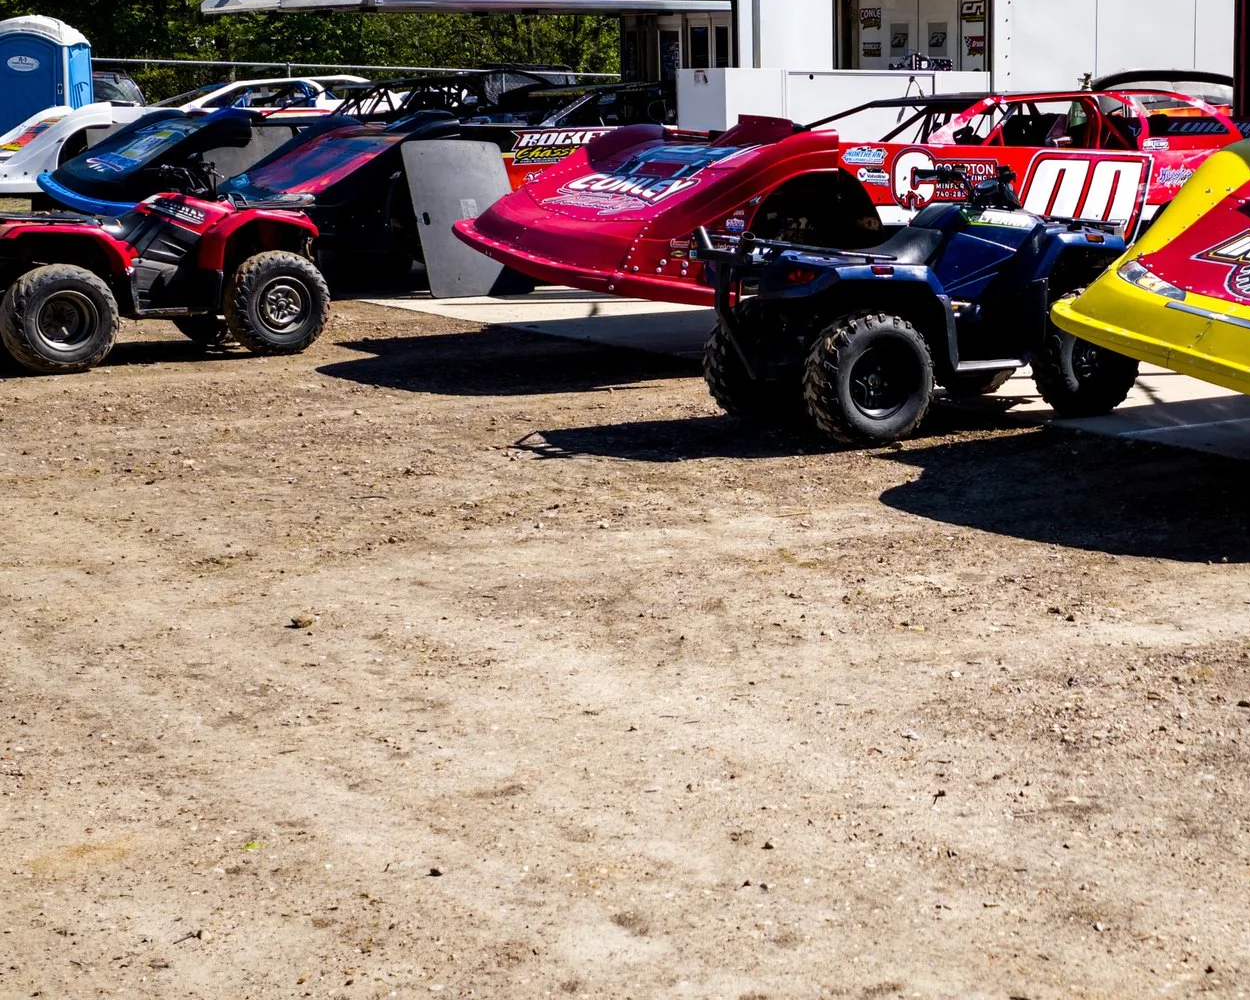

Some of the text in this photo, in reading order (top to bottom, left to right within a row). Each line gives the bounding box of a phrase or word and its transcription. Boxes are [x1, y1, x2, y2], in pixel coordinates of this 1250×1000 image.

[518, 131, 611, 147] ROCKE
[935, 163, 994, 176] COPTON
[568, 172, 696, 201] CONLEY
